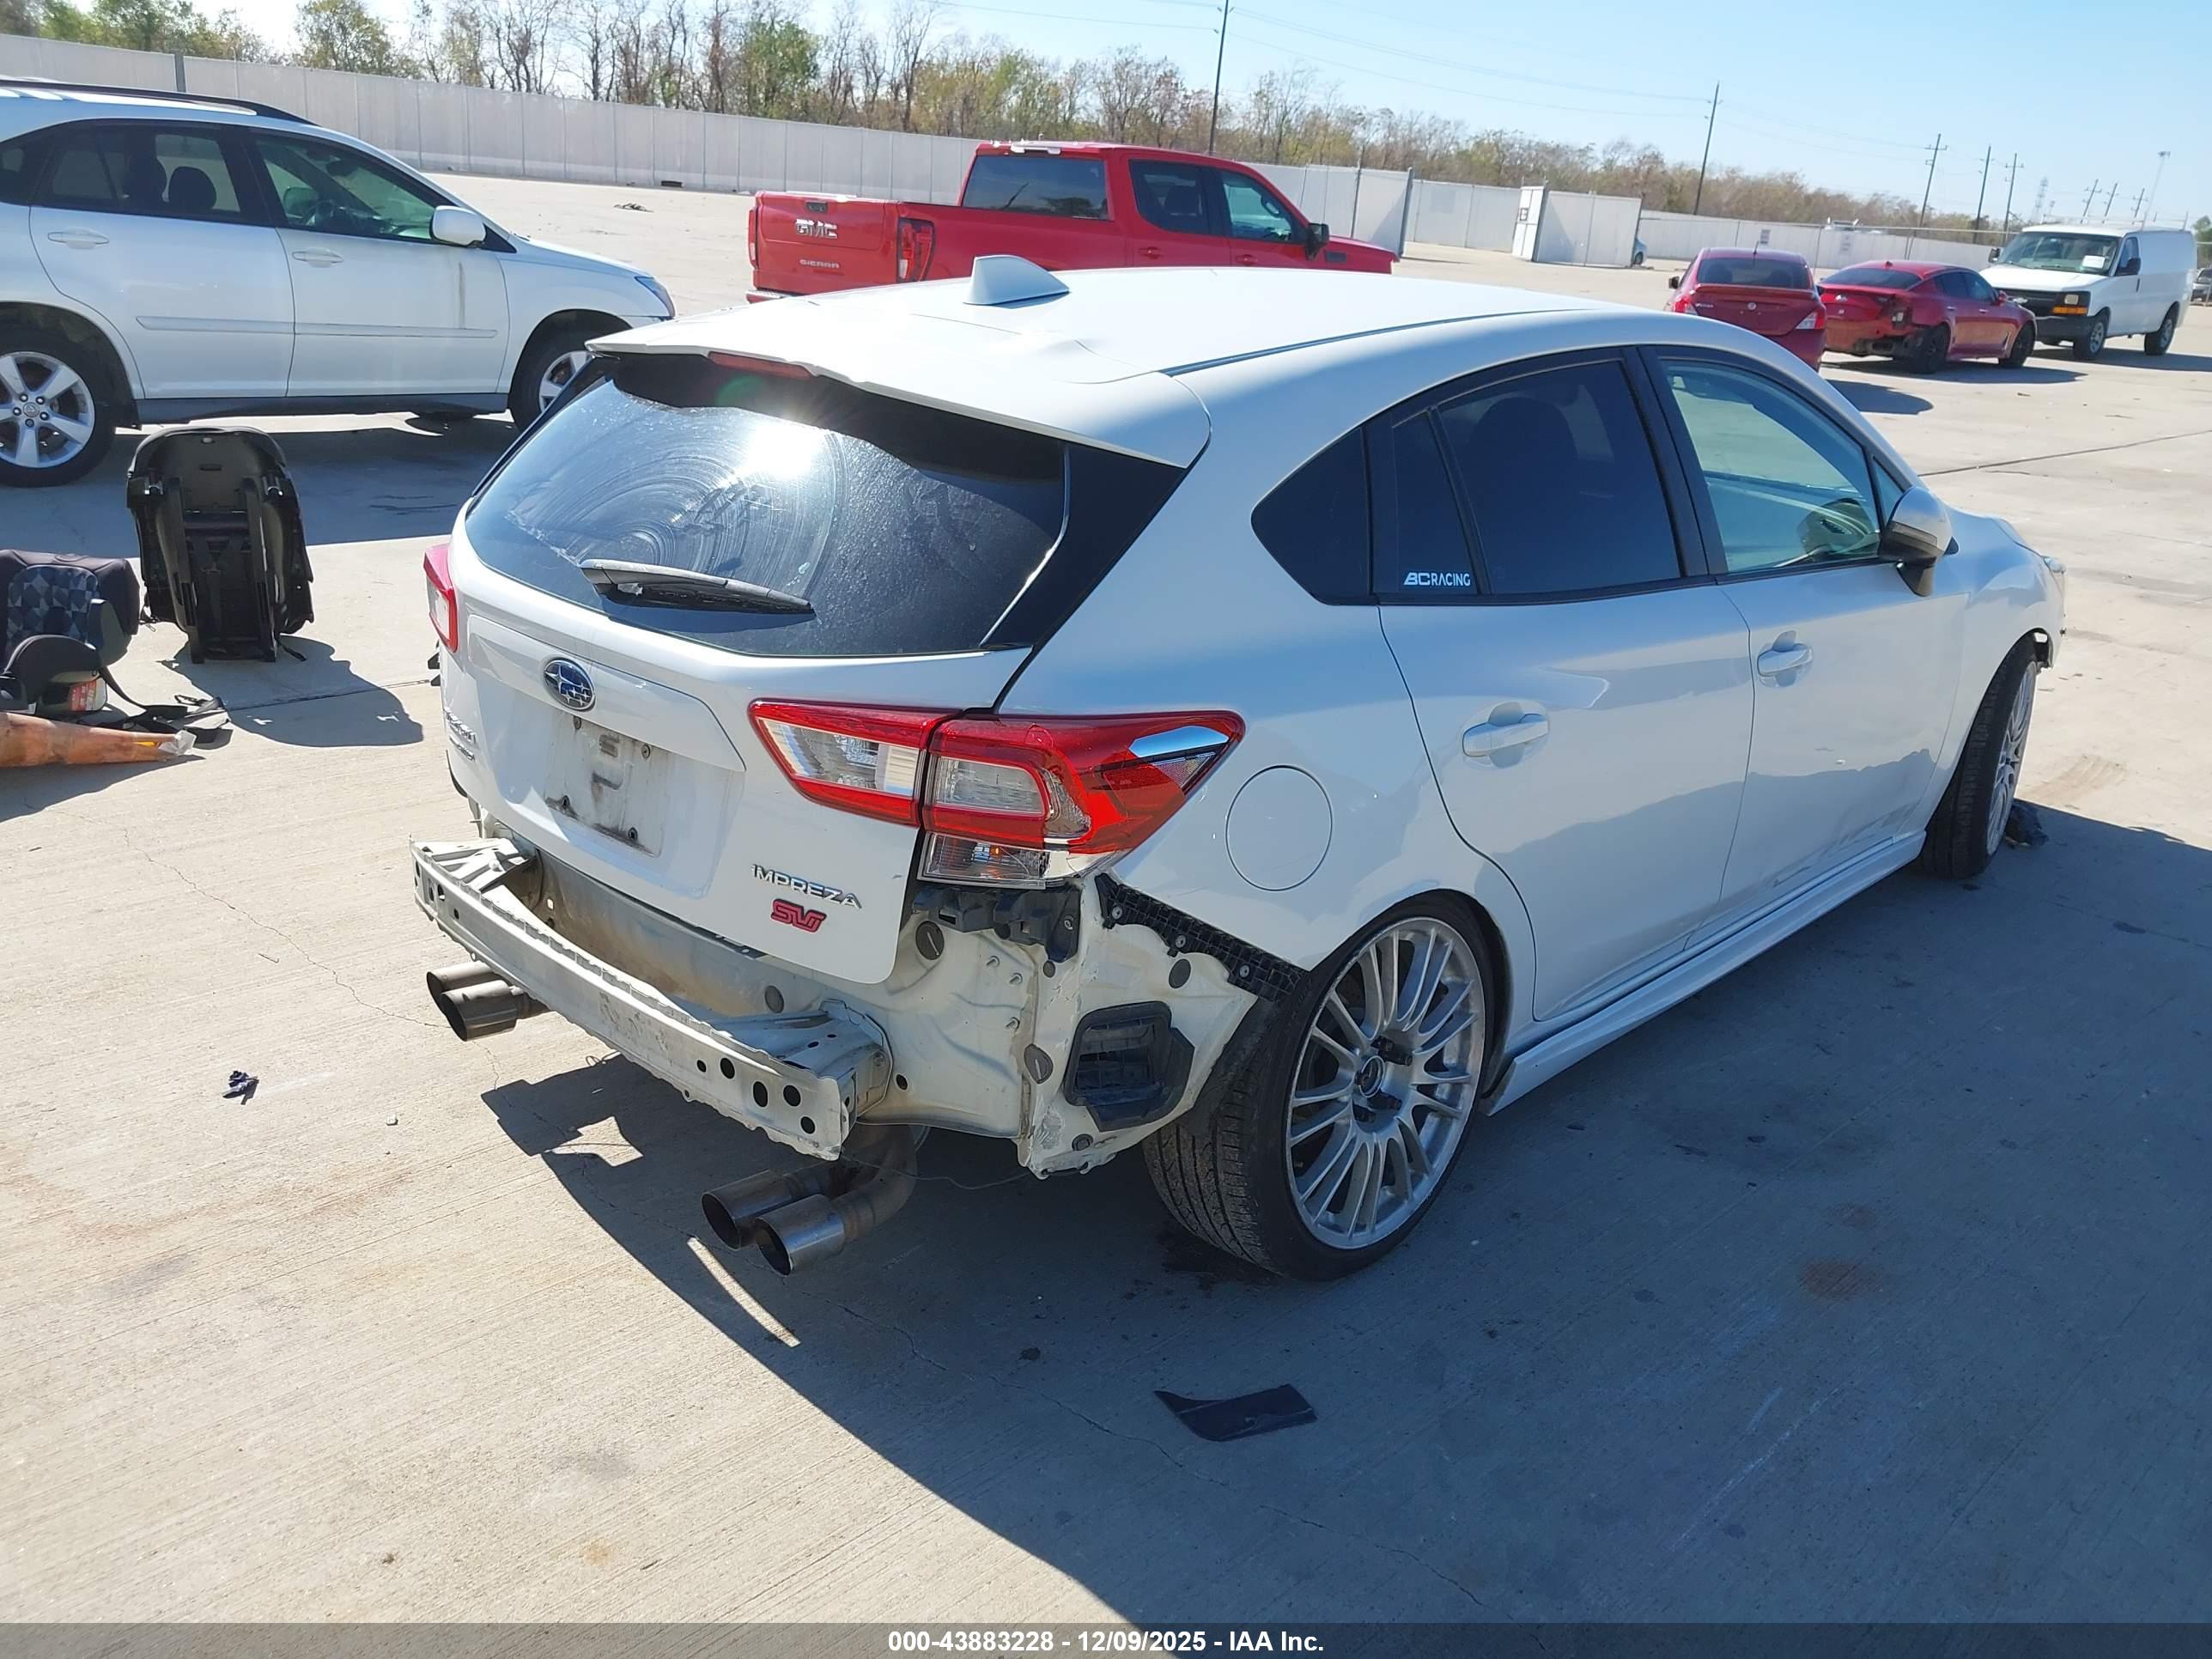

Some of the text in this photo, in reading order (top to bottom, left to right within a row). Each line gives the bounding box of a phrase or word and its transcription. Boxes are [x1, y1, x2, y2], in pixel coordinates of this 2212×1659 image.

[795, 218, 838, 239] GMC
[799, 258, 840, 269] SIERRA
[750, 863, 862, 909] IMPREZA
